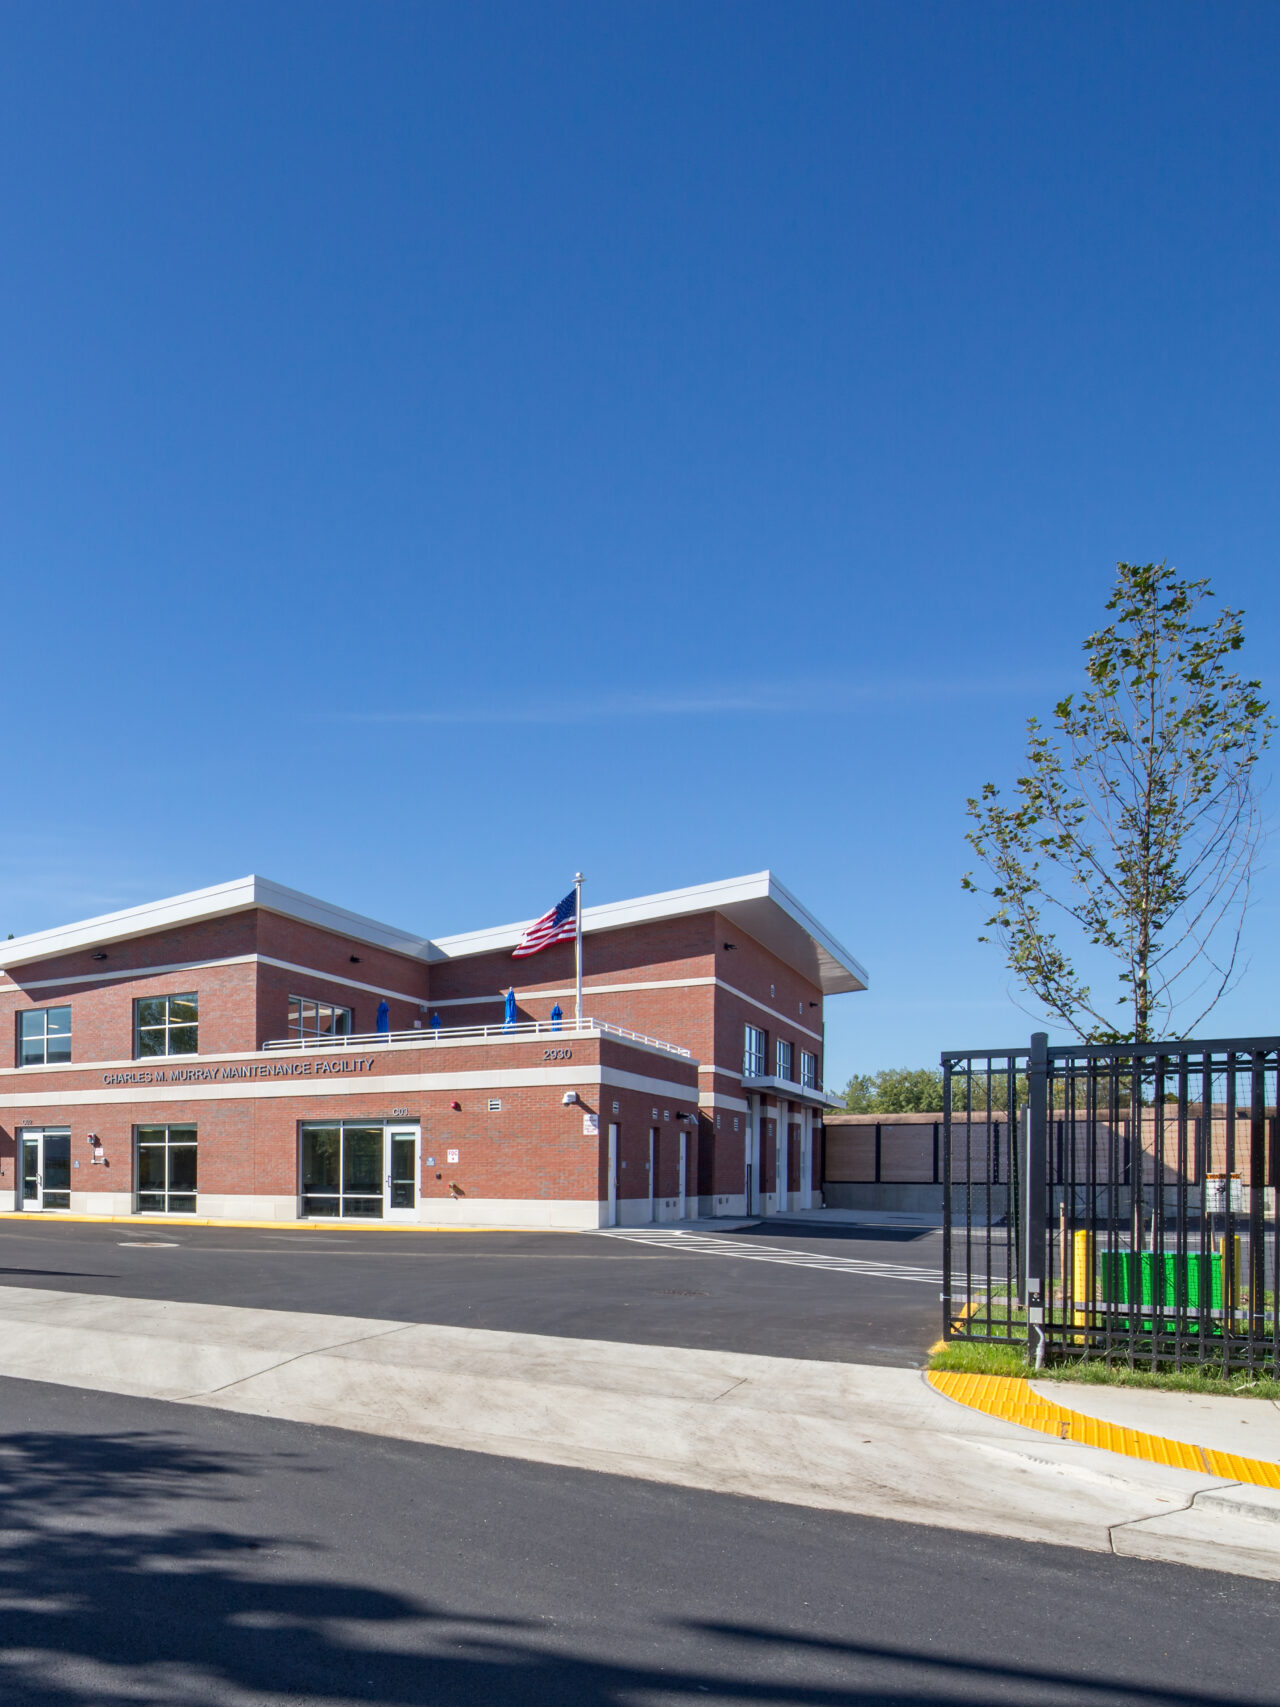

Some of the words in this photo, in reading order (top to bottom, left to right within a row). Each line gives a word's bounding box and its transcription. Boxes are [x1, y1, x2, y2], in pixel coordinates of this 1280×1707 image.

[543, 1048, 573, 1060] 2930
[103, 1072, 152, 1085] CHARLES
[155, 1071, 168, 1082] M.
[170, 1066, 219, 1081] MURRAY
[222, 1062, 311, 1079] MAINTENANCE
[314, 1059, 374, 1074] FACILITY
